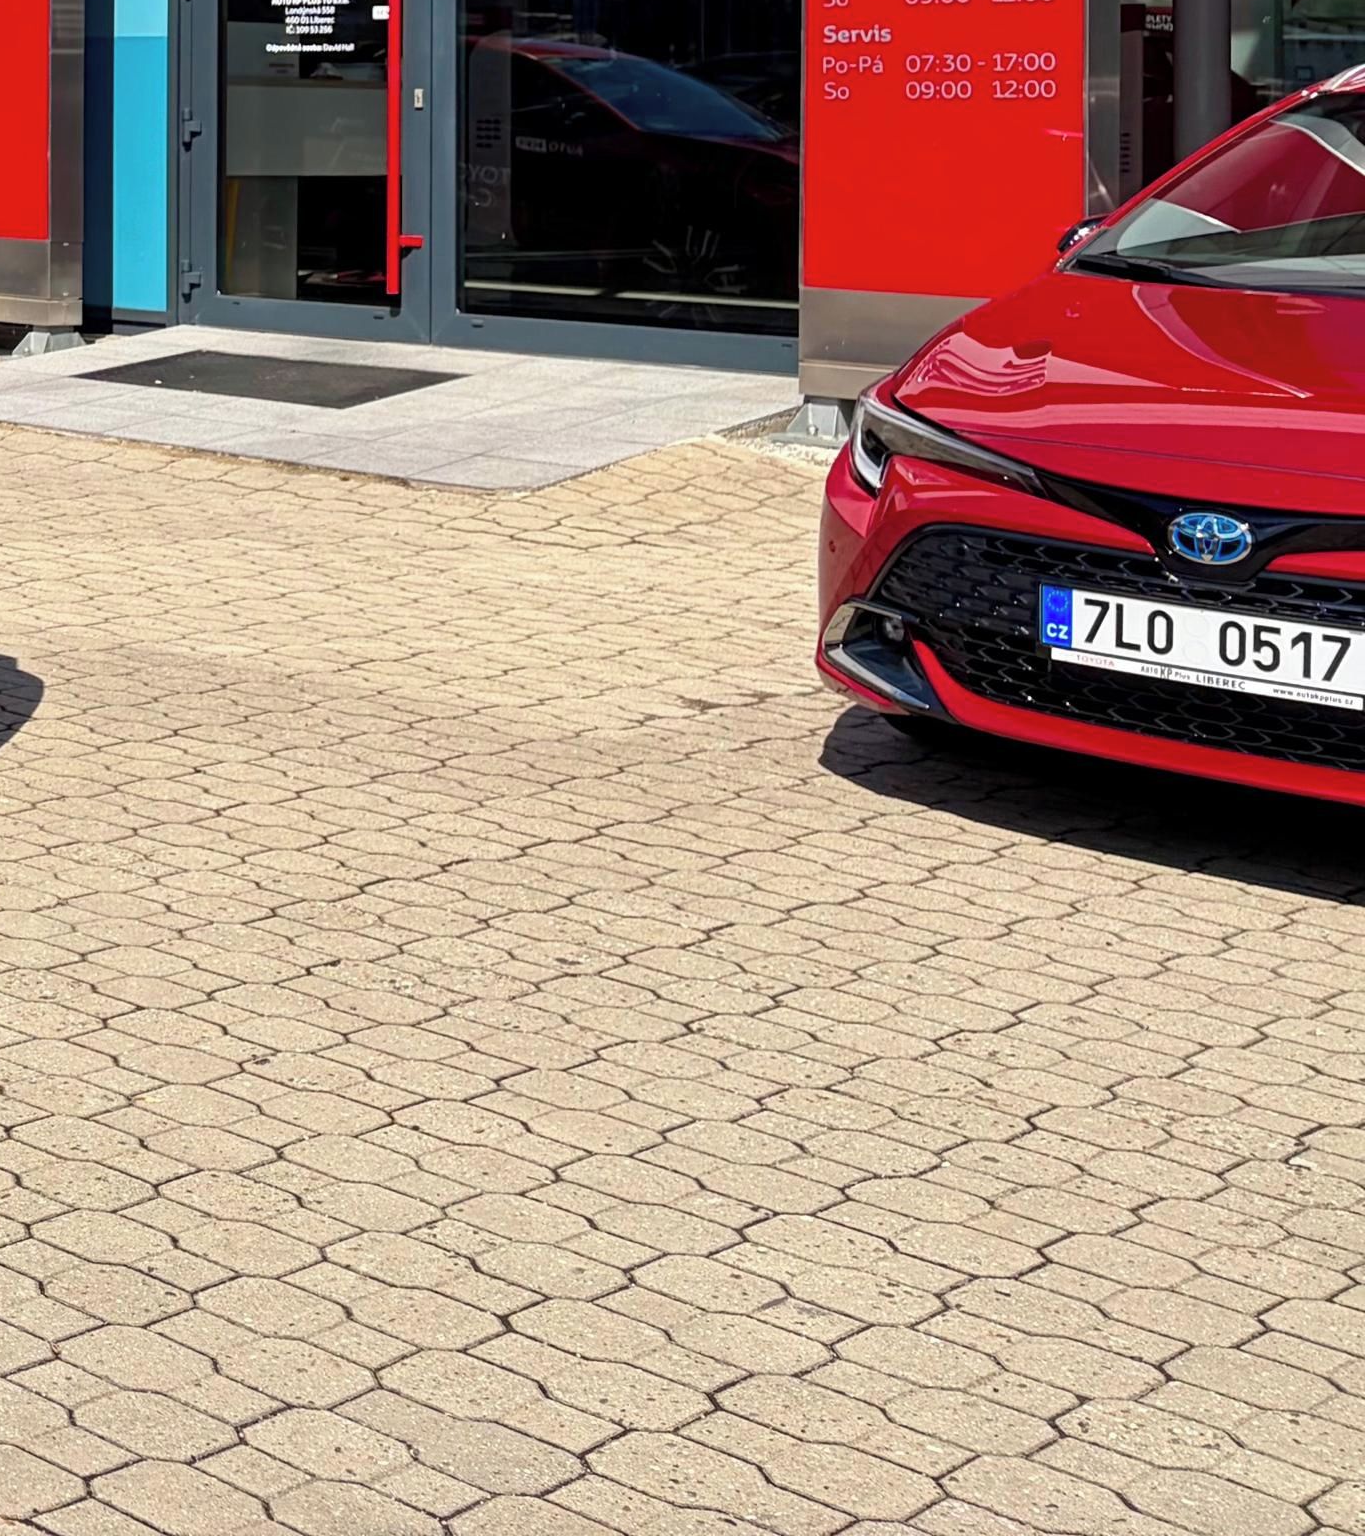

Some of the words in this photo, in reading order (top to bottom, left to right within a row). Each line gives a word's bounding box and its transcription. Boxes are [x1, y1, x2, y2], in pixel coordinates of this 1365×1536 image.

[823, 24, 892, 44] Servis
[822, 54, 884, 74] Po-Pá
[906, 54, 971, 73] 07:30
[992, 52, 1056, 71] 17:00
[824, 81, 850, 100] So
[906, 80, 972, 99] 09:00
[992, 79, 1056, 98] 12:00
[1046, 623, 1069, 639] CZ
[1084, 598, 1174, 655] 7L0
[1219, 621, 1351, 682] 0517
[1077, 654, 1115, 668] TOYOTA
[1160, 666, 1173, 678] KP
[1196, 674, 1246, 690] LIBEREC
